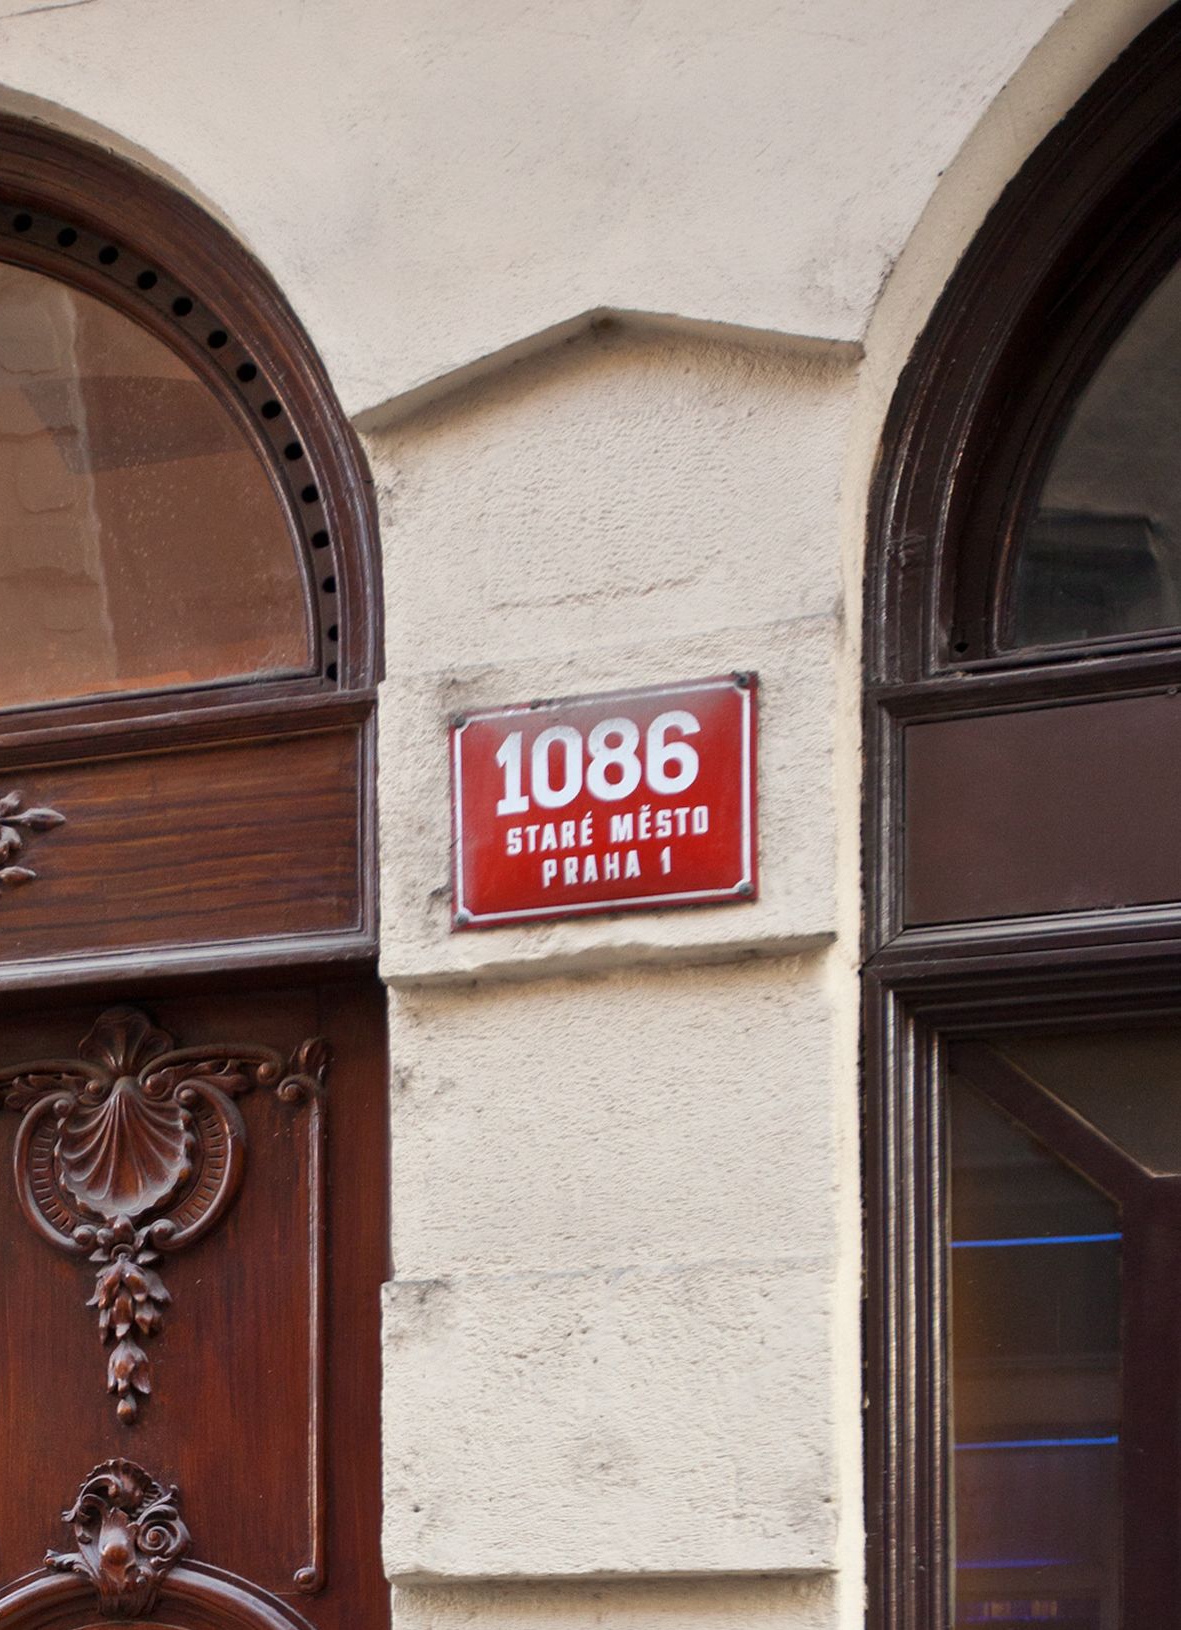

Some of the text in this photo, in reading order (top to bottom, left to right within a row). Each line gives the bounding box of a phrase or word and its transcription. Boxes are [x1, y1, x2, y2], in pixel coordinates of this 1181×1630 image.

[496, 711, 701, 816] 1086
[506, 804, 709, 855] STARÉ MĚSTO
[542, 846, 673, 888] PRAHA 1
